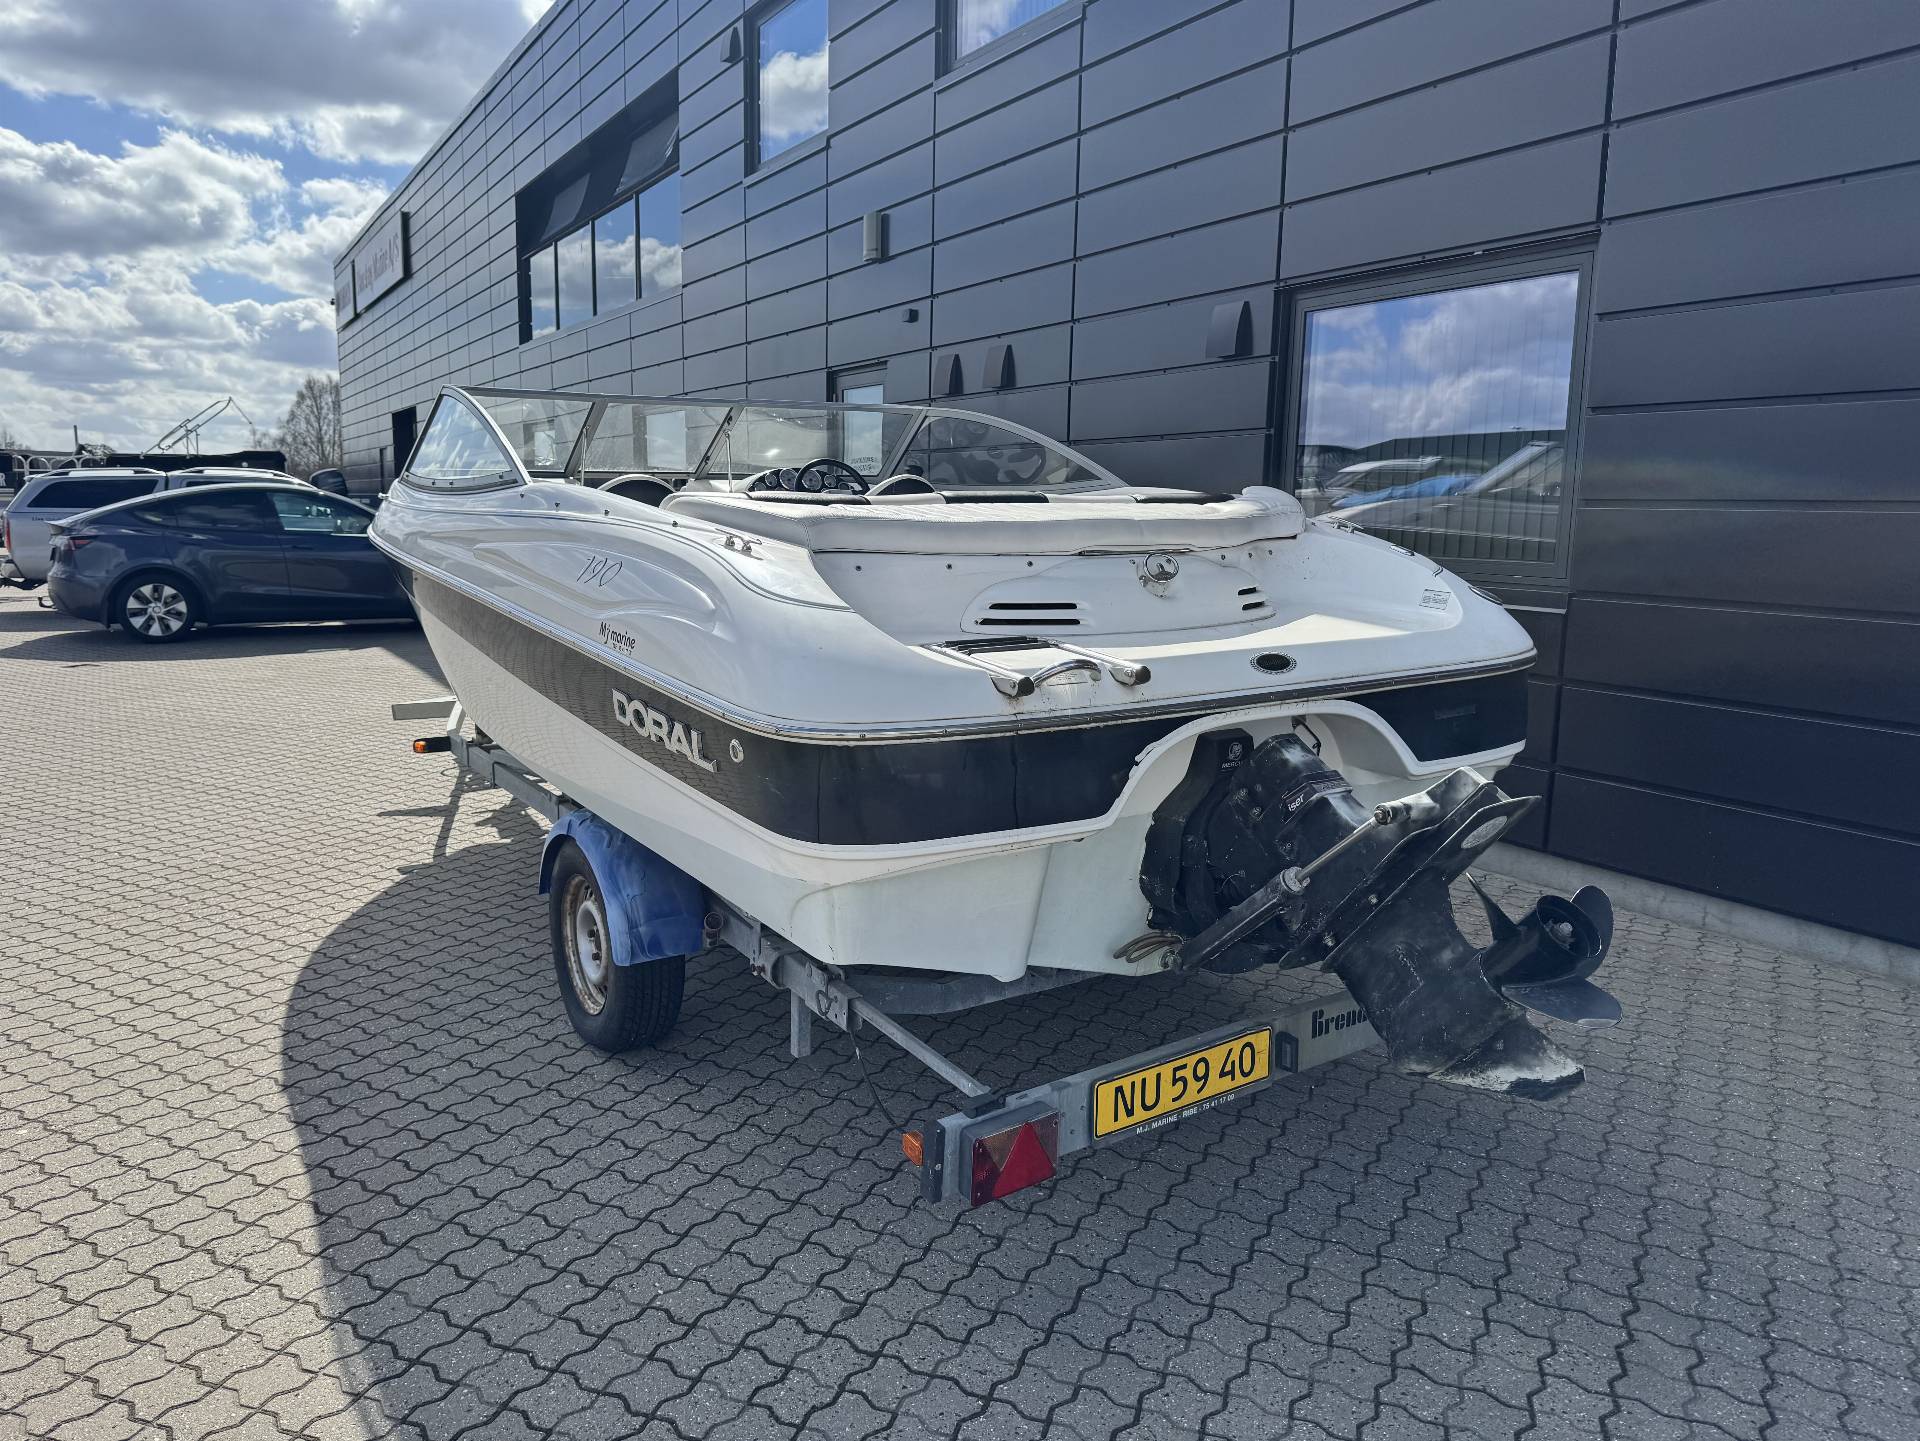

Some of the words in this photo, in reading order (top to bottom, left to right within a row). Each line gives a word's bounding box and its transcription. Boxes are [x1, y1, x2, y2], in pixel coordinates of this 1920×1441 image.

[610, 630, 636, 649] marine
[612, 688, 718, 773] DORAL
[1113, 1072, 1163, 1123] NU
[1170, 1056, 1210, 1103] 59
[1218, 1041, 1257, 1082] 40
[1151, 1113, 1178, 1129] MARINE
[1182, 1106, 1198, 1118] RIBE
